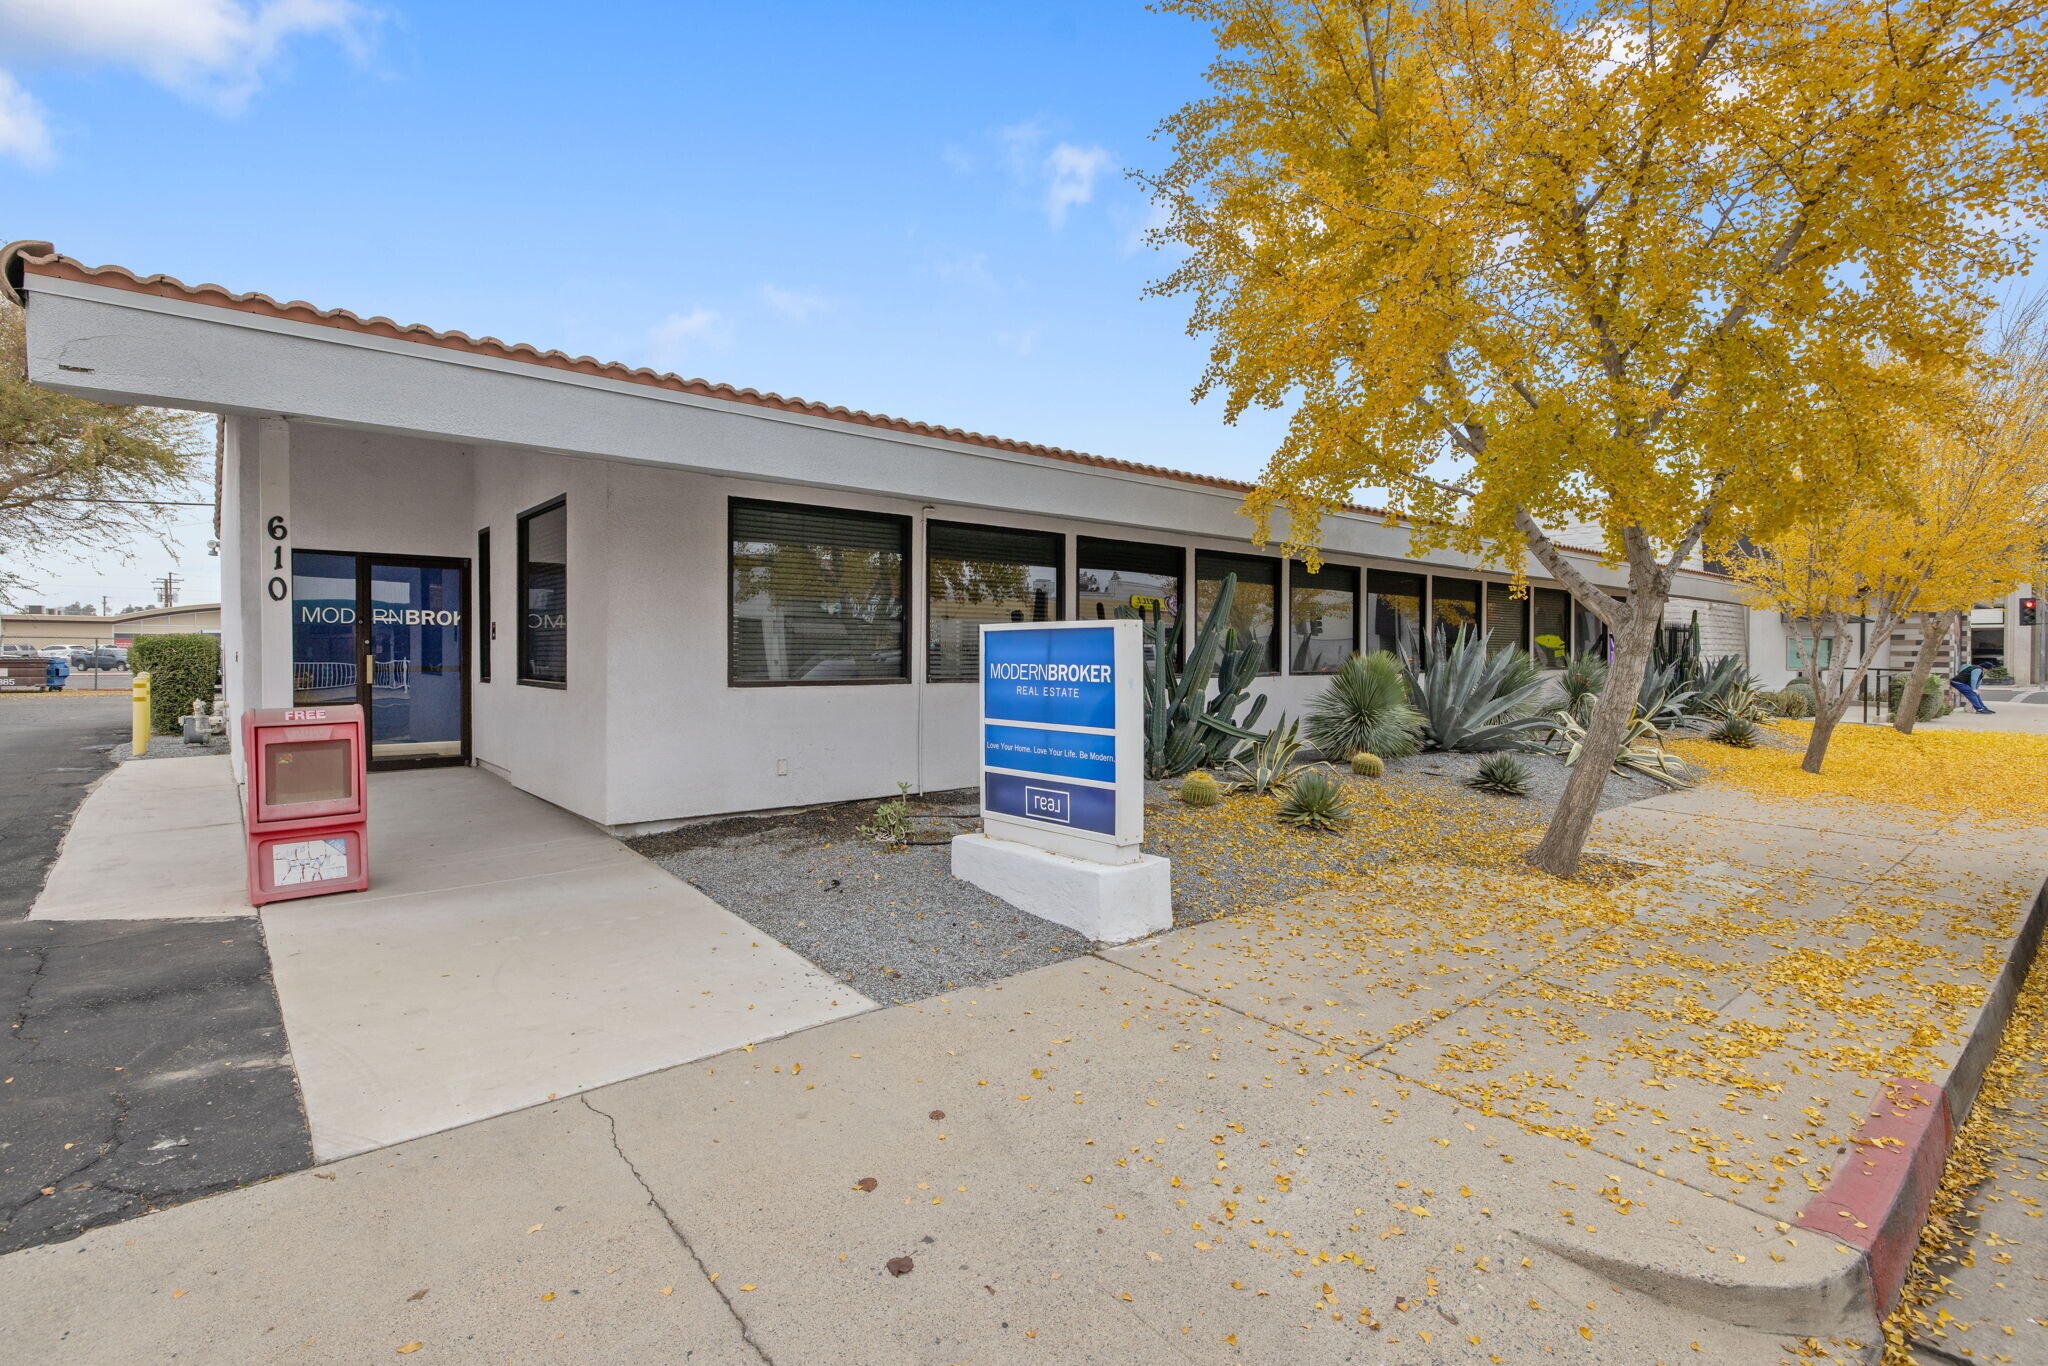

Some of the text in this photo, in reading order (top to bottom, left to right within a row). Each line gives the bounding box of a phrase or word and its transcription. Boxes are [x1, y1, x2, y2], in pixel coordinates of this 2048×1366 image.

[267, 515, 288, 601] 610
[990, 663, 1111, 683] MODERNBROKER
[1016, 685, 1080, 698] REAL ESTATE
[285, 709, 327, 721] FREE
[986, 741, 1116, 763] Love Your Home. Love Your Life. Be Modern.
